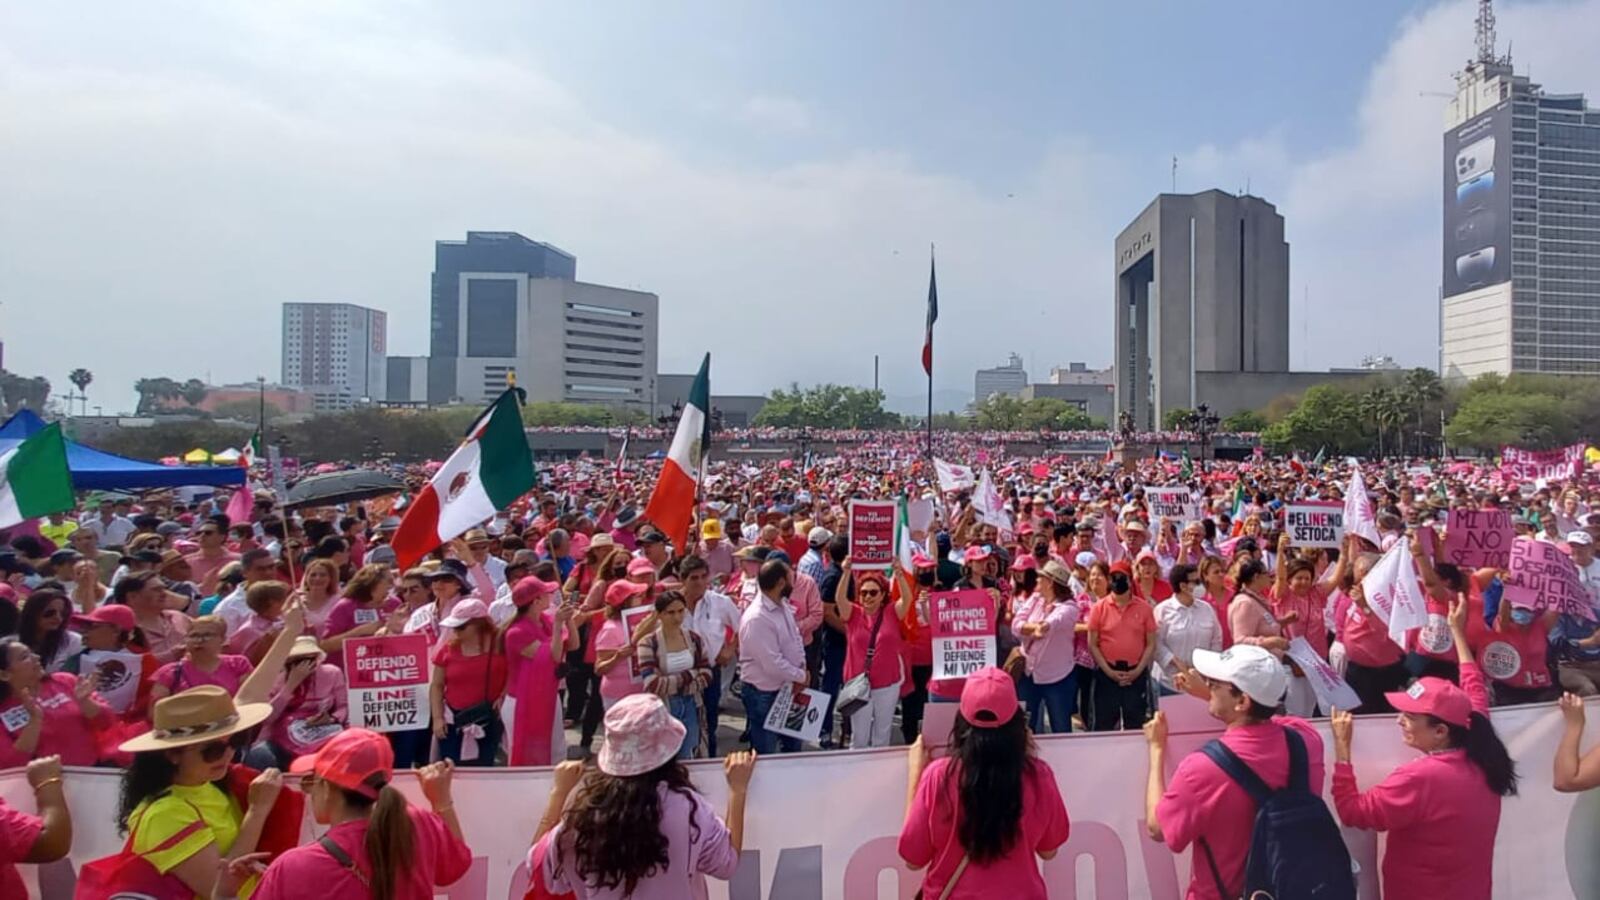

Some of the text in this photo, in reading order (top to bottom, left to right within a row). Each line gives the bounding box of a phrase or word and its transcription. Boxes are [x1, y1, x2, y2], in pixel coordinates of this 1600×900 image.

[1288, 512, 1342, 527] #ELINENO
[1456, 511, 1478, 529] MI
[1294, 527, 1336, 541] SETOCA
[1464, 530, 1502, 549] NO
[953, 620, 987, 631] INE
[943, 640, 985, 650] EL INE
[356, 654, 416, 670] DEFIENDO
[944, 651, 986, 661] DEFIENDE
[374, 667, 420, 682] INE
[944, 663, 957, 675] MI
[363, 689, 417, 702] EL INE
[363, 699, 417, 713] DEFIENDE
[364, 710, 418, 728] MI VOZ
